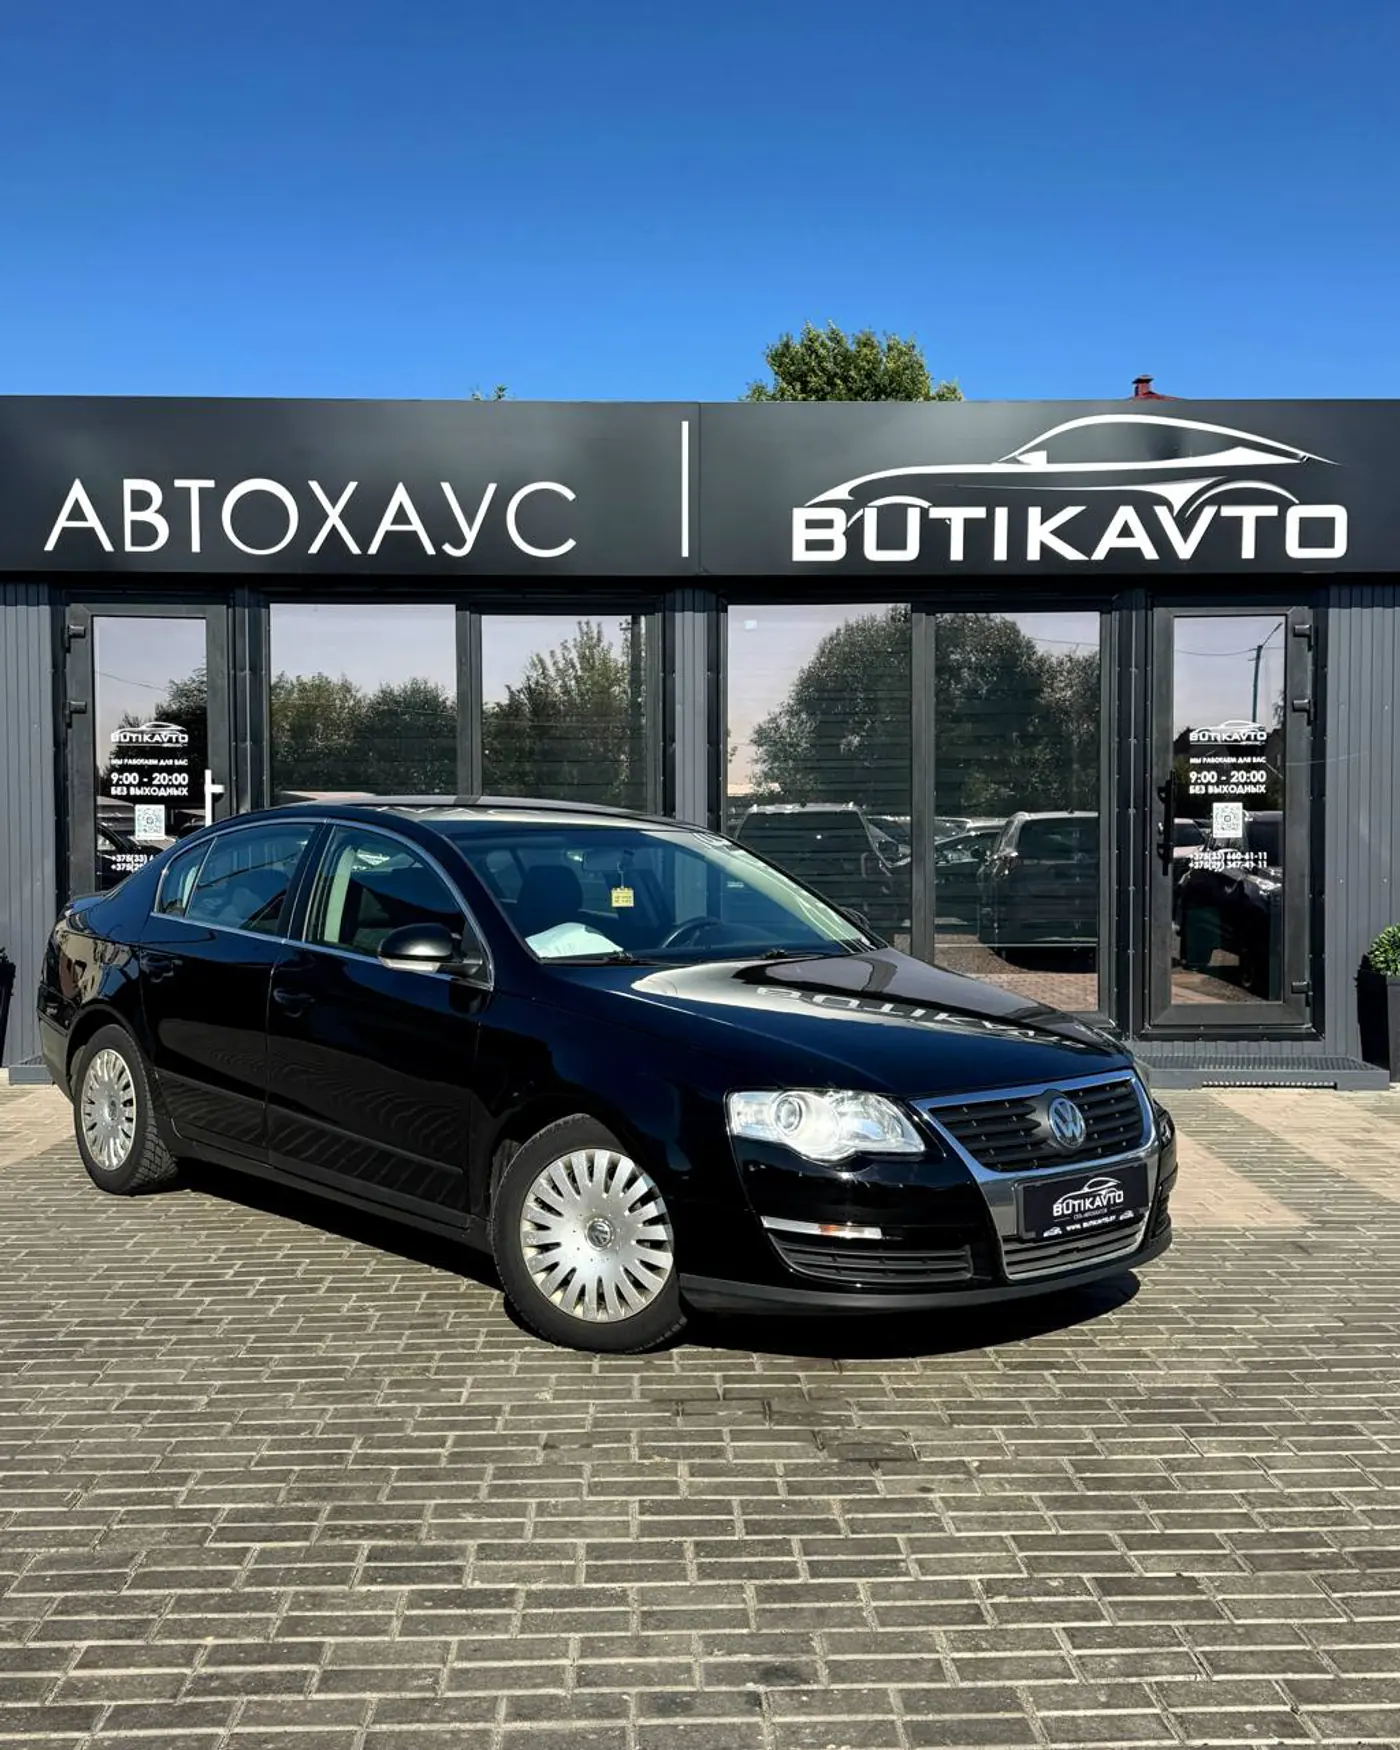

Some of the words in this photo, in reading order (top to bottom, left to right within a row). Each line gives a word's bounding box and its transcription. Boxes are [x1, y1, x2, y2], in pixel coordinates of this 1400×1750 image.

[43, 477, 578, 559] АВТОХАУС
[791, 503, 1350, 562] BUTIKAVTO
[110, 732, 189, 743] BUTIKAVTO
[1189, 731, 1267, 742] BUTIKAVTO
[110, 772, 140, 785] 9:00
[151, 772, 189, 785] 20:00
[1189, 770, 1218, 783] 9:00
[1230, 769, 1267, 783] 20:00
[110, 786, 128, 796] БЕЗ
[129, 786, 189, 796] ВЫХОДНЫХ
[1189, 785, 1206, 794] БЕЗ
[1207, 784, 1267, 794] ВЫХОДНЫХ
[1052, 1190, 1124, 1217] BUTIKAVTO
